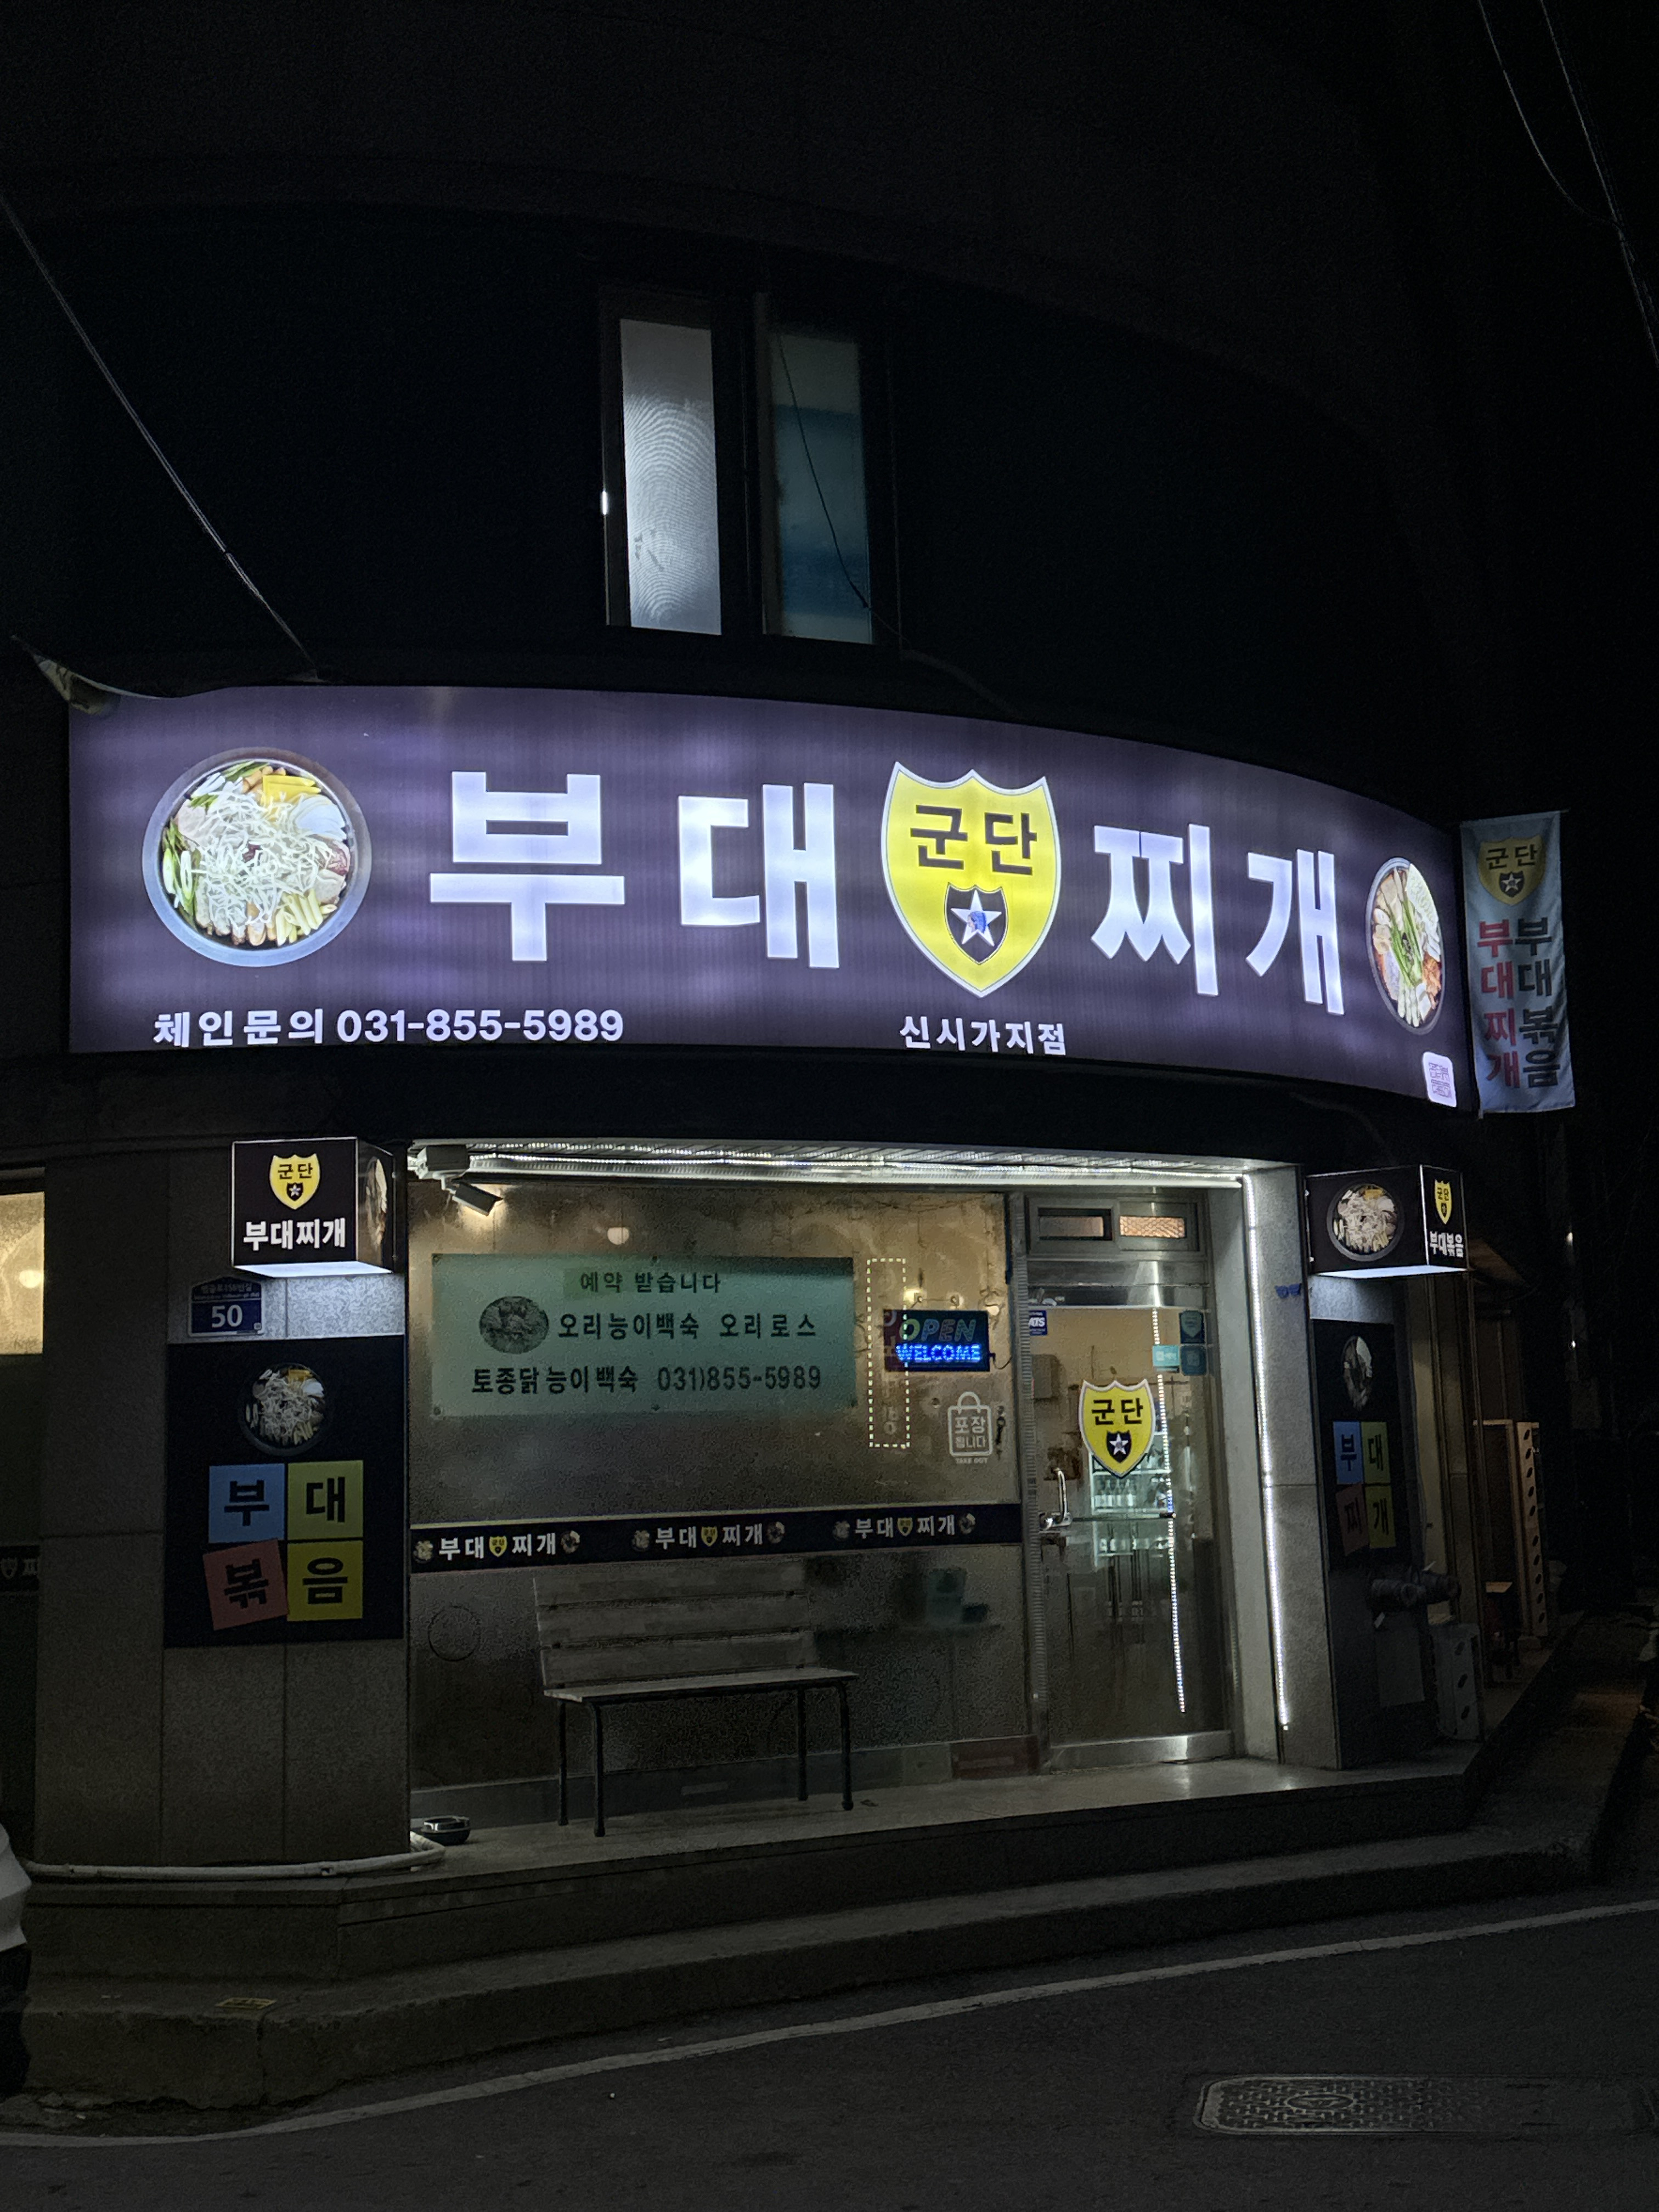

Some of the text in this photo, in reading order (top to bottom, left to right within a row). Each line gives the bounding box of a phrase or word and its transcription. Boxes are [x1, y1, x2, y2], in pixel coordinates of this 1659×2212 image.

[1486, 844, 1537, 870] 군단
[430, 771, 1345, 1015] 부대 군단 찌개
[336, 1009, 624, 1043] 031-855-5989
[900, 1015, 1066, 1055] 신시가지점
[277, 1163, 313, 1180] 군단
[243, 1217, 346, 1251] 부대찌개
[580, 1272, 720, 1293] 예약 받습니다
[211, 1304, 243, 1328] 50
[558, 1313, 816, 1340] 오리능이백숙 오리로스
[899, 1318, 977, 1342] OPEN
[895, 1344, 982, 1363] WELCOME
[658, 1365, 821, 1391] 031)855-5989
[955, 1416, 986, 1434] 포장
[1091, 1398, 1143, 1425] 군단
[1341, 1433, 1384, 1471] 부대
[224, 1476, 346, 1527] 부대
[655, 1523, 763, 1550] 부대 찌개
[854, 1514, 955, 1540] 부대 찌개
[439, 1532, 556, 1561] 부대 찌개
[224, 1557, 348, 1609] 볶음
